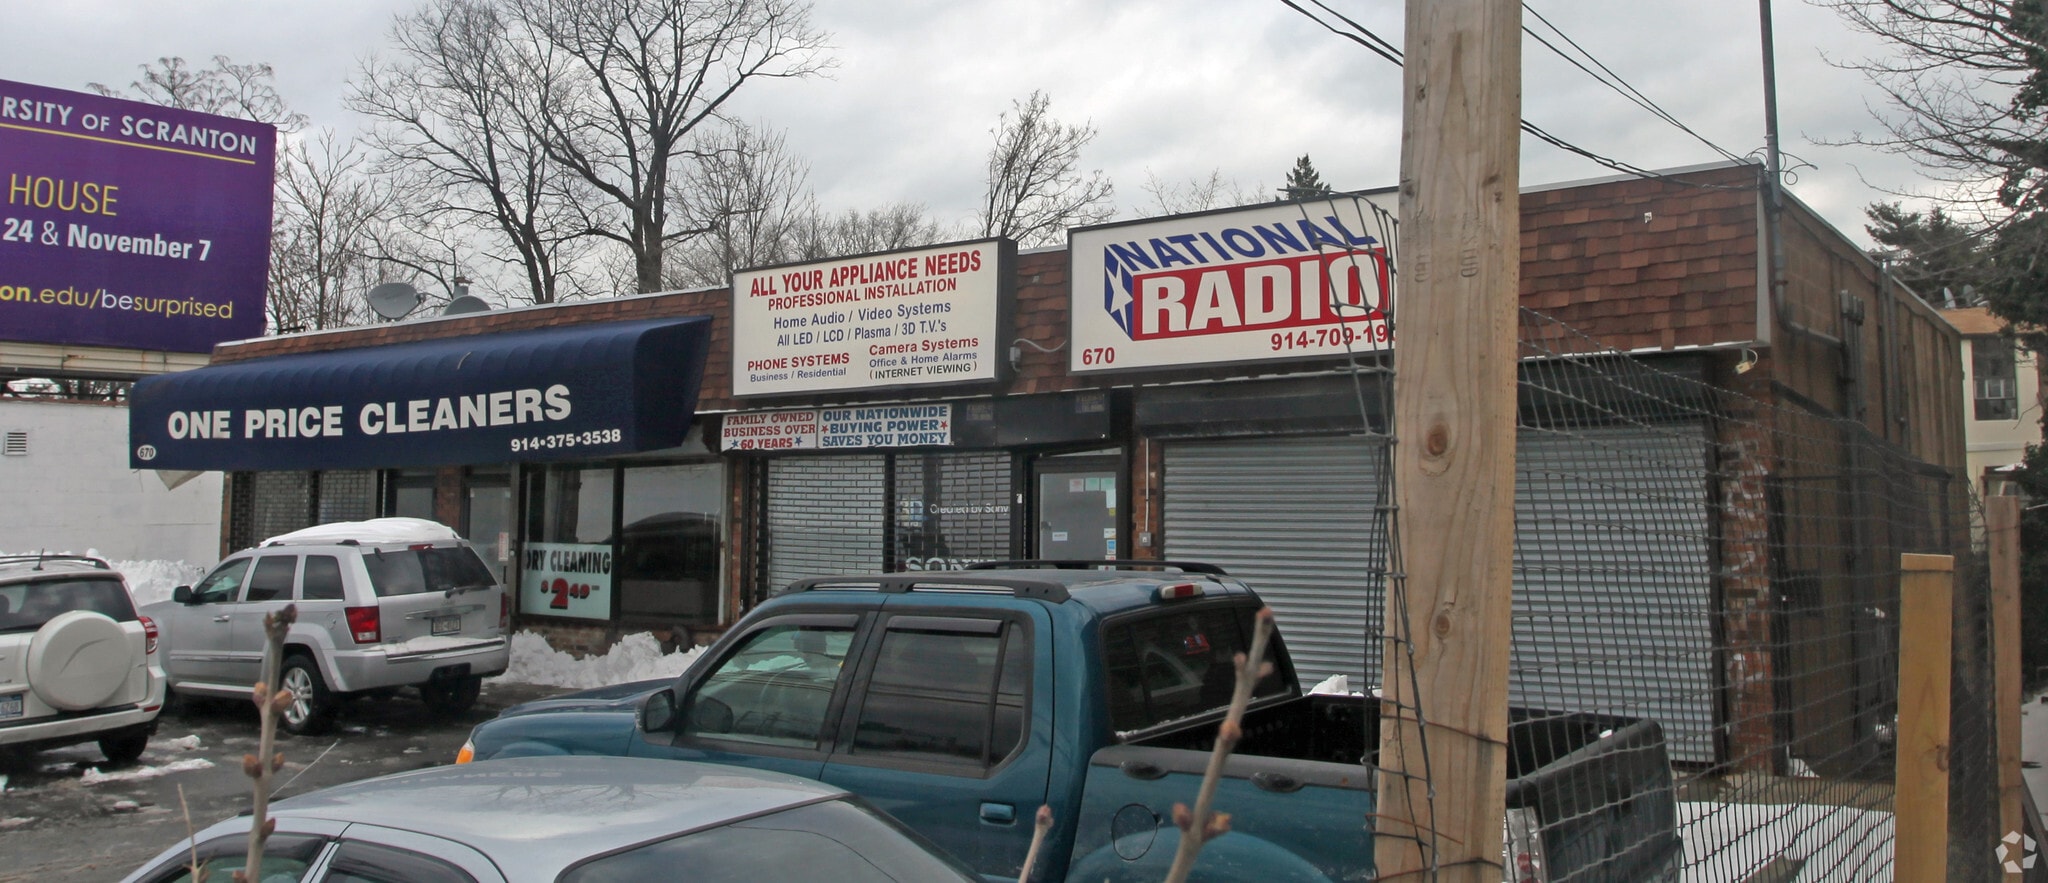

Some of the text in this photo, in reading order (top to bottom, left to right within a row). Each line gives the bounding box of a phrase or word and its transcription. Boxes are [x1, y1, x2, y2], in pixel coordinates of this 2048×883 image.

[0, 96, 256, 155] RSITY OF SCRANTON
[9, 173, 119, 216] HOUSE
[2, 218, 211, 262] 24 & November 7
[1108, 216, 1379, 272] NATIONAL
[750, 250, 981, 298] ALL YOUR APPLIANCE NEEDS
[768, 278, 957, 311] PROFESSIONAL INSTALLATION
[1142, 254, 1380, 335] RADIO
[774, 315, 807, 329] Home
[811, 311, 845, 325] Audio
[858, 307, 893, 321] Video
[897, 301, 951, 318] Systems
[777, 333, 790, 347] All
[793, 331, 813, 345] LED
[823, 328, 844, 343] LCD
[854, 325, 891, 340] Plasma
[902, 322, 915, 335] 3D
[1271, 324, 1396, 351] 914-709-19
[869, 337, 979, 356] Camera Systems
[1082, 347, 1115, 365] 670
[747, 352, 850, 371] PHONE SYSTEMS
[869, 351, 977, 368] Office & Home Alarms
[750, 371, 788, 383] Business
[797, 367, 847, 379] Residential
[168, 384, 572, 440] ONE PRICE CLEANERS
[727, 411, 814, 425] FAMILY OWNED
[823, 406, 948, 421] OUR NATIONWIDE
[724, 424, 816, 437] BUSINESS OVER
[830, 420, 939, 434] BUYING POWER
[740, 438, 793, 450] 60 YEARS
[822, 432, 947, 447] SAVES YOU MONEY
[139, 447, 155, 458] 670
[550, 550, 611, 574] CLEANING
